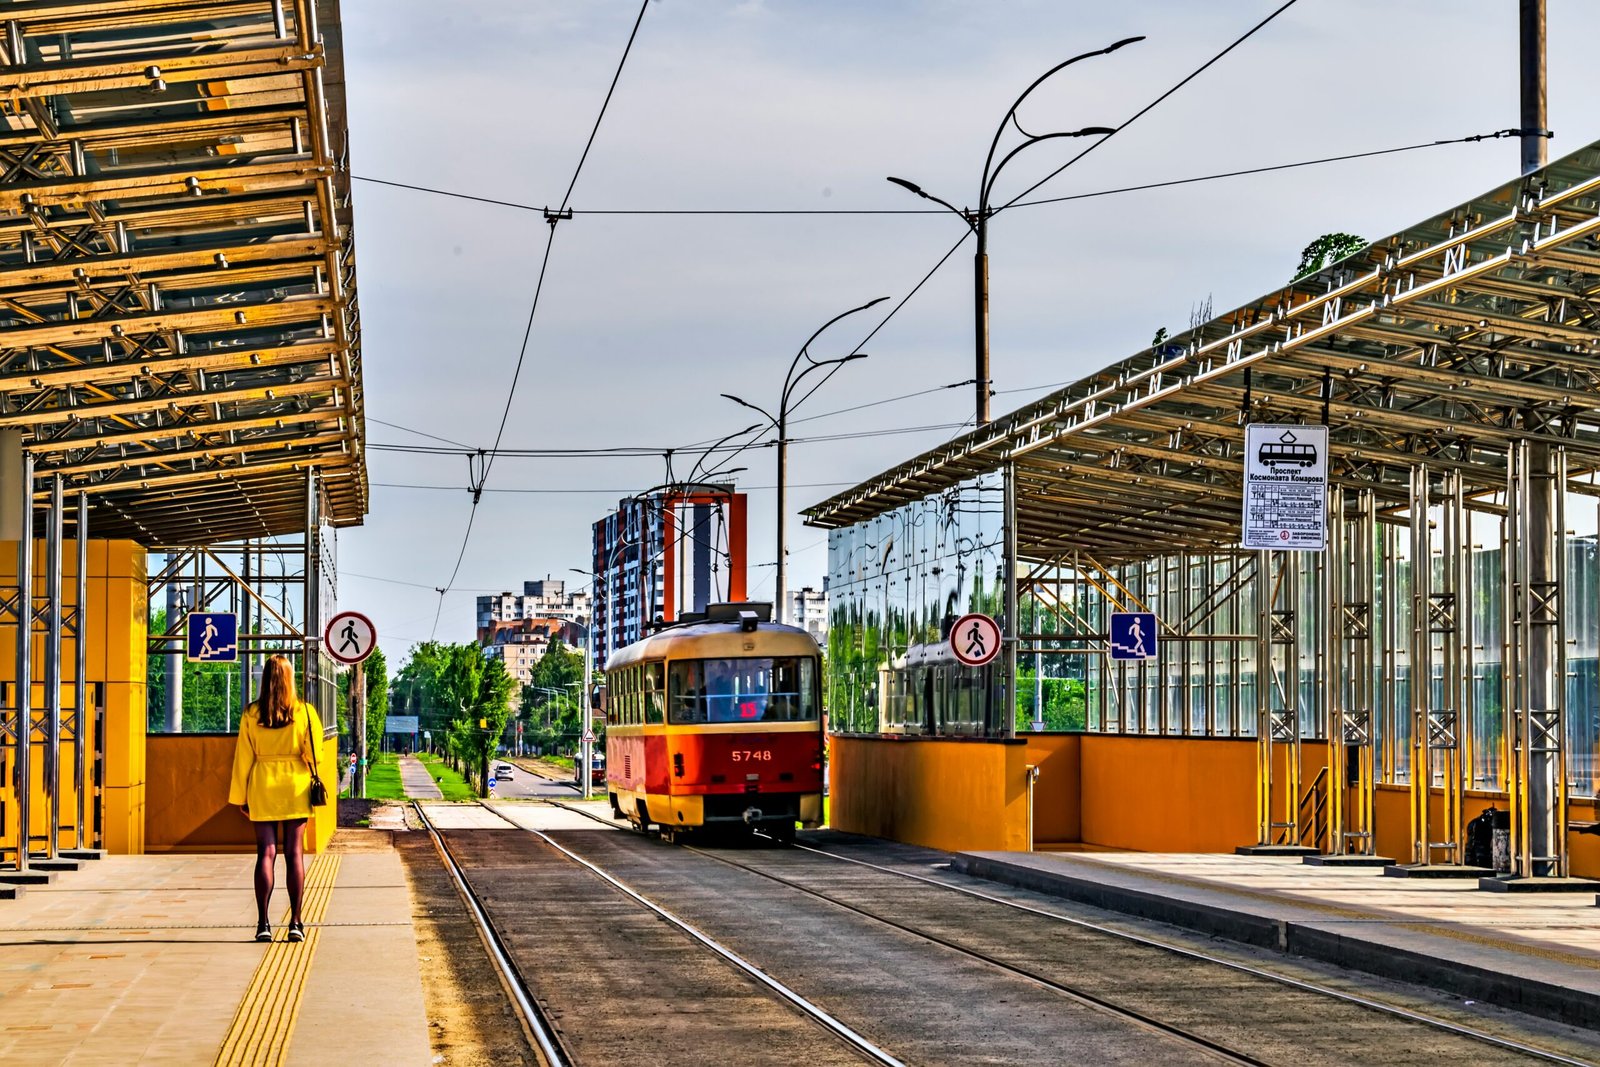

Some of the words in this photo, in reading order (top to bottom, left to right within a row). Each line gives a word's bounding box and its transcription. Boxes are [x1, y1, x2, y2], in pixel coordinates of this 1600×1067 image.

[1270, 467, 1302, 475] Проспект
[1291, 475, 1323, 484] Комарова
[740, 702, 757, 718] 15
[732, 750, 772, 761] 5748
